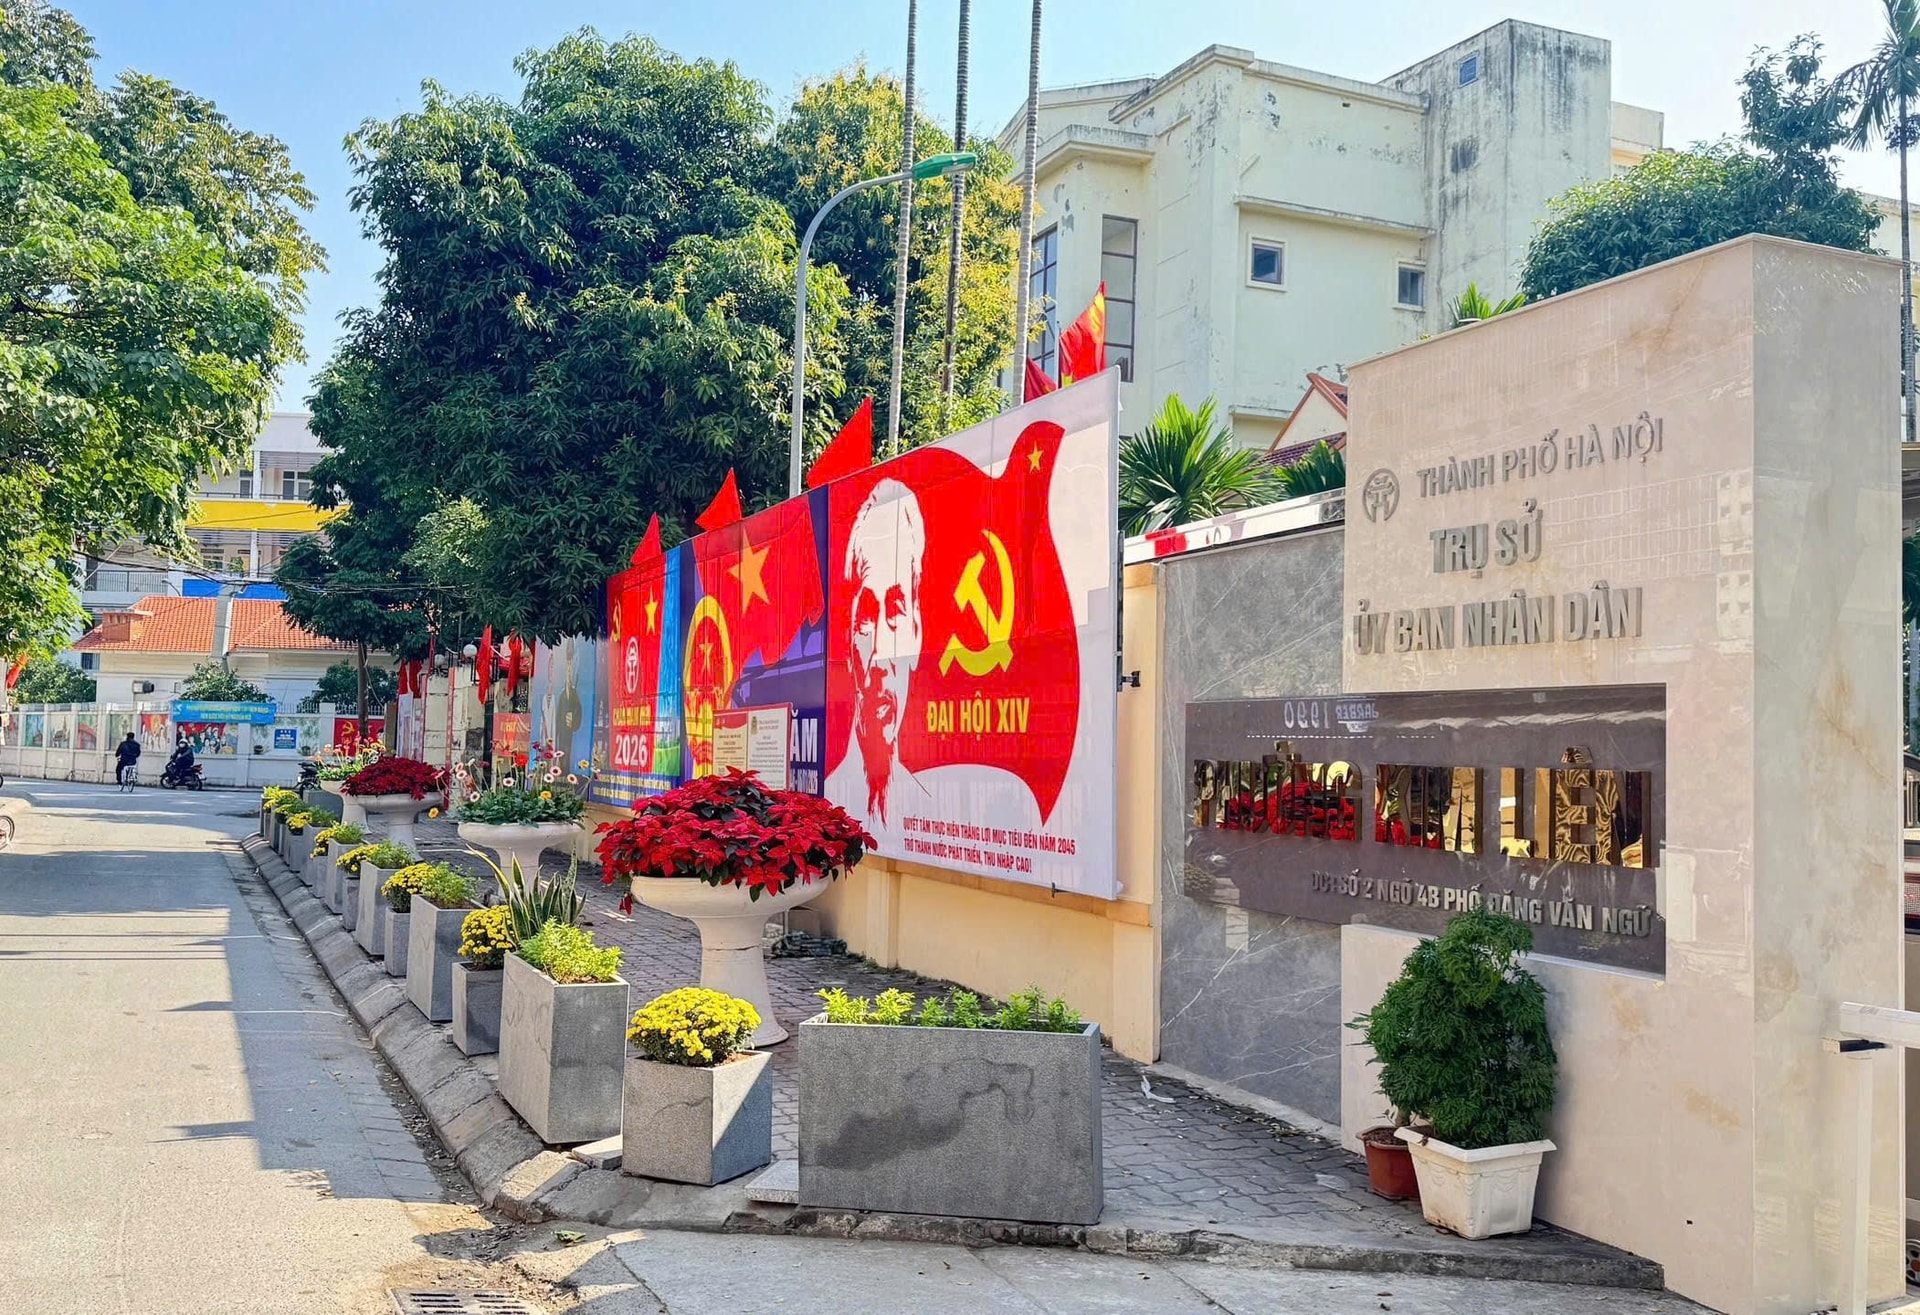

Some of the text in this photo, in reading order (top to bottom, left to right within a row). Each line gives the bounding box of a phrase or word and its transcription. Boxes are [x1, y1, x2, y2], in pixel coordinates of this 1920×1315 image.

[1417, 411, 1663, 498] THÀNH PHỐ HÀ NỘI
[1430, 499, 1543, 578] TRỤ SỞ
[1353, 580, 1642, 655] ỦY BAN NHÂN DÂN
[790, 709, 818, 762] ĂM
[926, 690, 1030, 741] ĐẠI HỘI XIV
[614, 734, 648, 767] 2026
[1194, 740, 1651, 868] PHƯỜNG KIM LIÊN
[1016, 856, 1032, 873] CAO!
[1057, 838, 1076, 855] 2045
[1363, 877, 1374, 899] 2
[1377, 878, 1412, 905] NGÕ
[1416, 883, 1440, 909] 4B
[1444, 883, 1482, 912] PHỐ
[1550, 897, 1595, 930] VĂN
[1602, 904, 1652, 937] NGỮ
